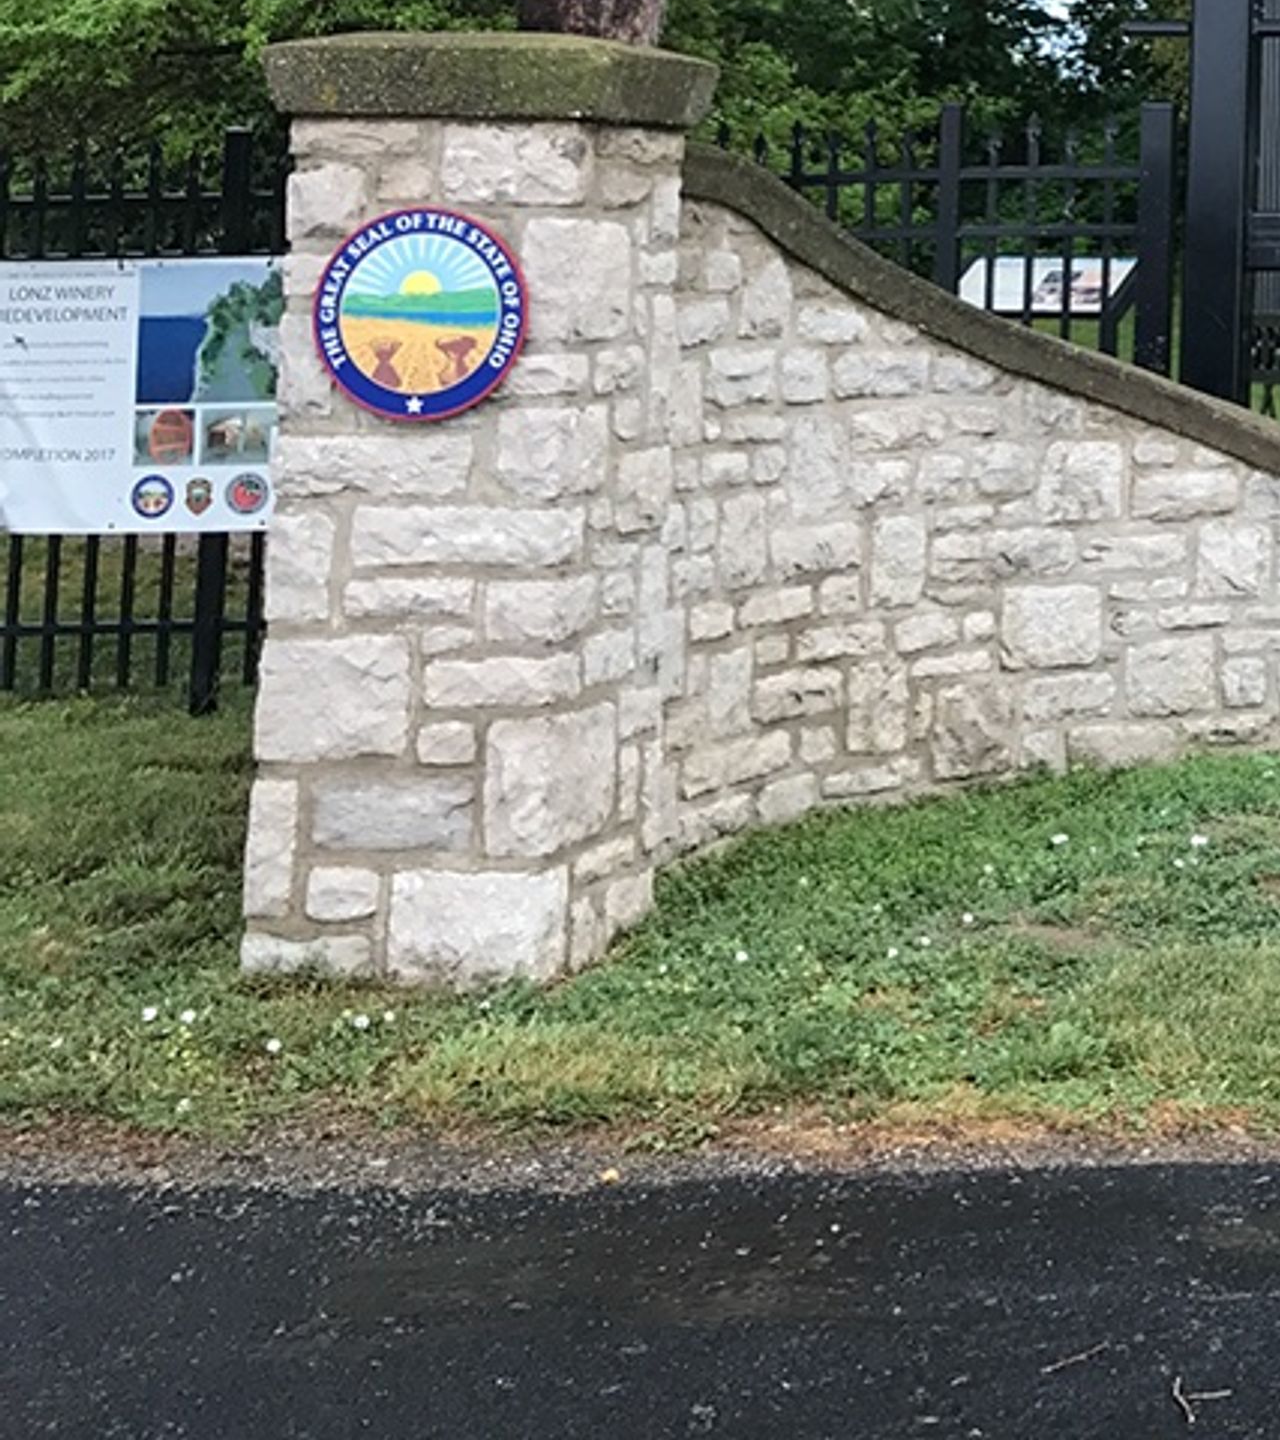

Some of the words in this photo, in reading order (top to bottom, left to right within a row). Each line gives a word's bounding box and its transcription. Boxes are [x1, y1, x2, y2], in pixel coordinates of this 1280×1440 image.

[395, 213, 424, 231] OF
[425, 213, 467, 237] THE
[347, 222, 395, 259] SEAL
[465, 229, 513, 280] STATE
[9, 286, 52, 301] LONZ
[54, 285, 116, 301] WINERY
[320, 258, 351, 324] GREAT
[501, 282, 520, 308] OF
[320, 328, 347, 370] THE
[489, 312, 520, 369] OHIO
[0, 447, 82, 463] OMPLETION
